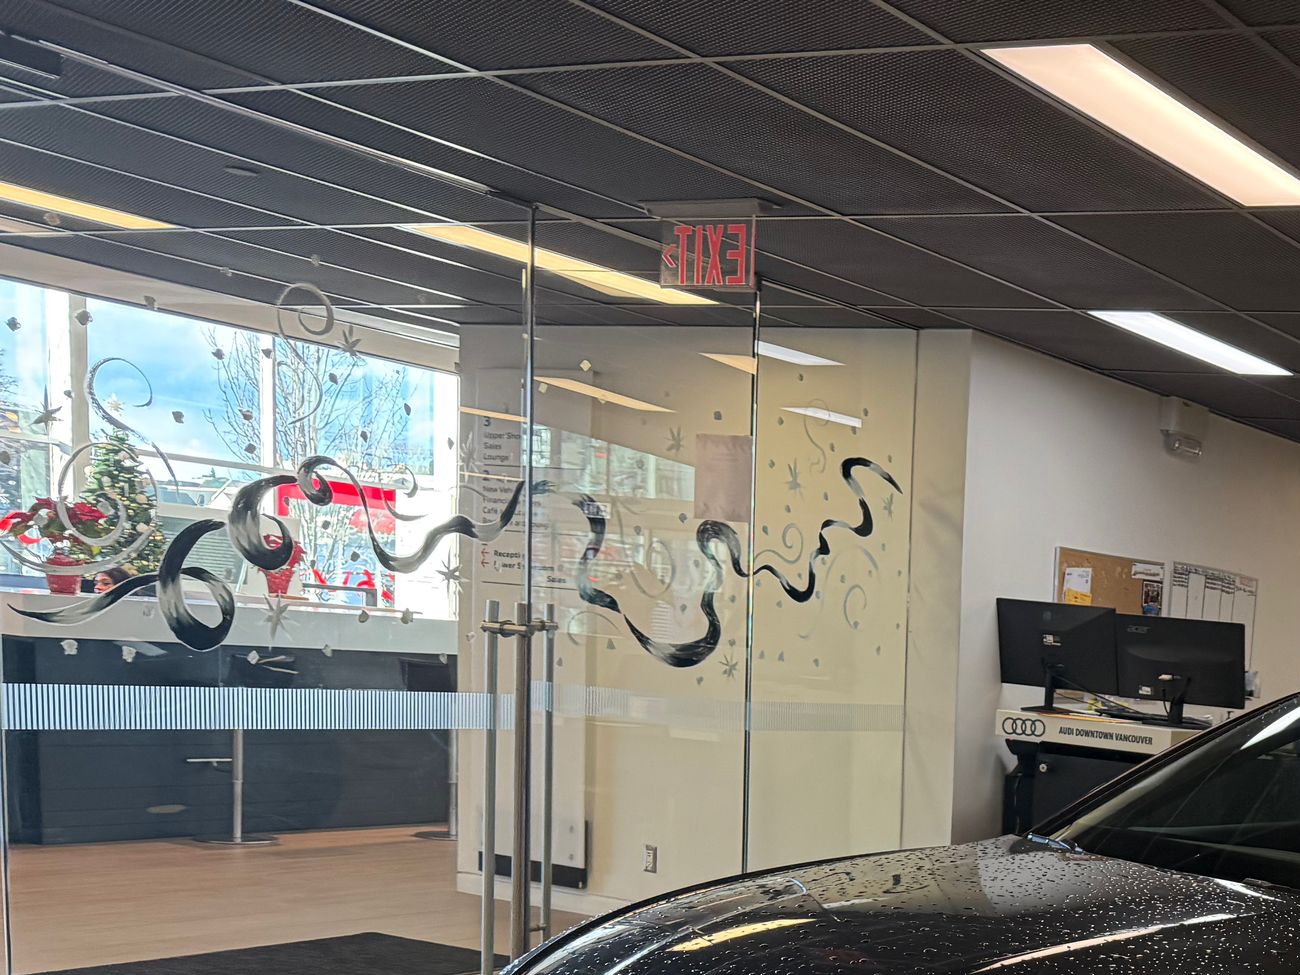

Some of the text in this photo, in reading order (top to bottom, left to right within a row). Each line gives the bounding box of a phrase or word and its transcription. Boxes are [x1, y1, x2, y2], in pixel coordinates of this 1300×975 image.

[483, 441, 502, 450] Sales
[483, 453, 509, 462] Lounge
[493, 549, 524, 559] Recepti
[1058, 726, 1153, 745] AUDI DOWNTOWN VANCOUVER
